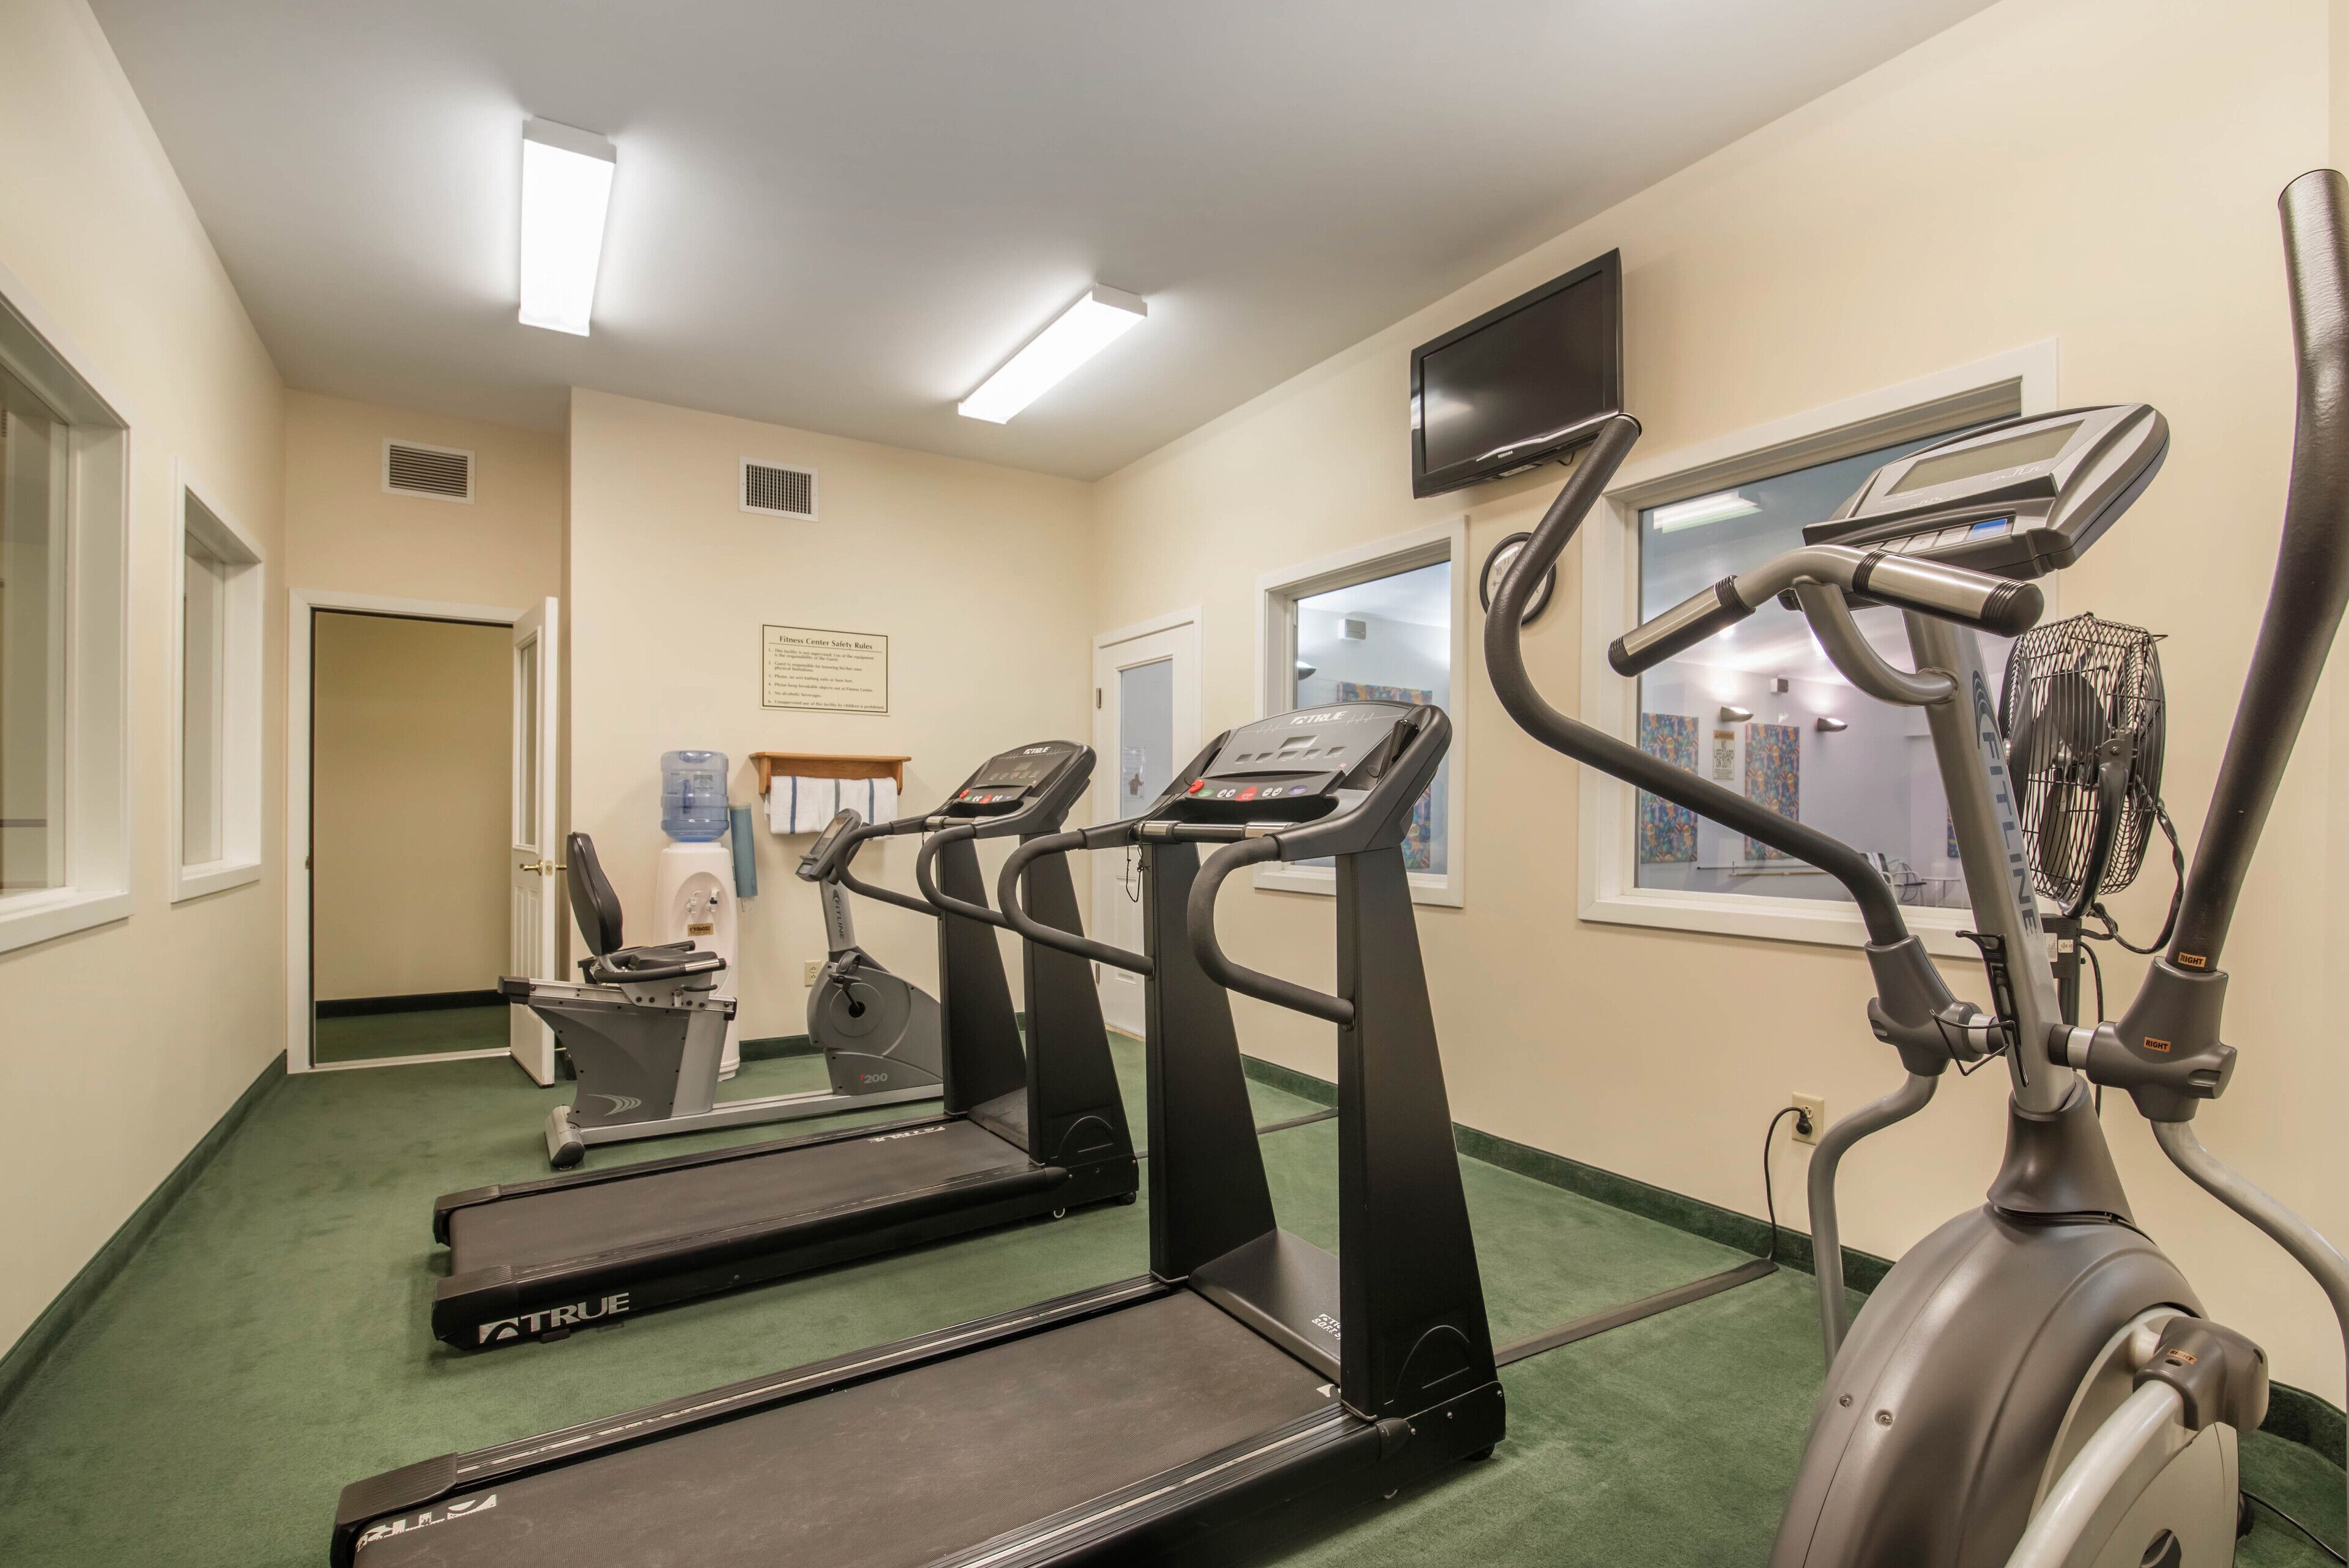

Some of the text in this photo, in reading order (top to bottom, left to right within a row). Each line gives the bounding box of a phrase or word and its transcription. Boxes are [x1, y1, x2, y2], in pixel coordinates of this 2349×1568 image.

[1496, 567, 1502, 576] 10
[779, 635, 803, 644] Fitness
[831, 640, 852, 649] Safety
[1306, 711, 1347, 723] TRUE
[1982, 731, 2039, 938] FITLINE
[834, 899, 845, 940] FITLINE
[2180, 954, 2203, 965] RIGHT
[2146, 1039, 2168, 1050] RIGHT
[521, 1292, 629, 1332] TRUE
[2170, 1350, 2194, 1361] RIGHT
